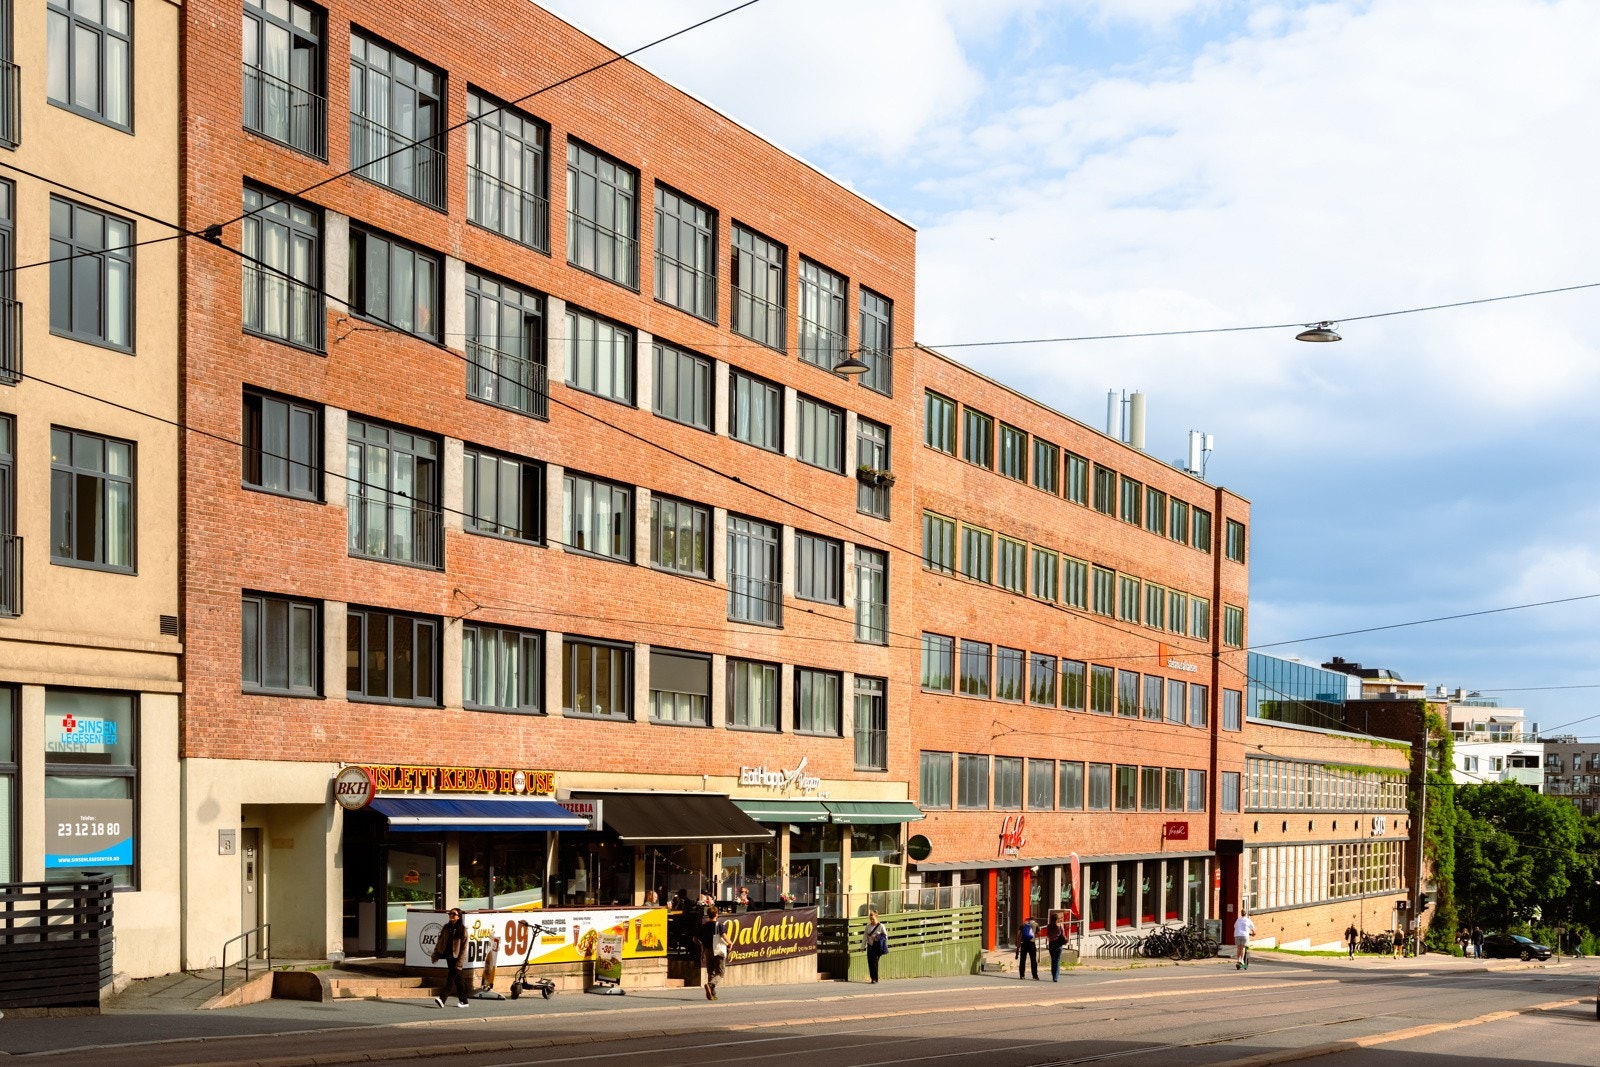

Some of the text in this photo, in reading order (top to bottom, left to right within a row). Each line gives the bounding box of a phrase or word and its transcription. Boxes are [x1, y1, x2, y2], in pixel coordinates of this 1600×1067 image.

[78, 720, 116, 734] SINSEN
[61, 733, 117, 745] LEGESENTER
[369, 766, 436, 790] ISLETT
[440, 768, 497, 791] KEBAB
[337, 782, 369, 795] BKH
[58, 823, 120, 836] 23 12 18 80
[723, 915, 813, 946] Valentino
[421, 935, 438, 945] BK
[504, 920, 529, 956] 99
[728, 949, 759, 963] Pizzeria
[759, 947, 766, 957] &
[766, 942, 798, 958] Gastropub
